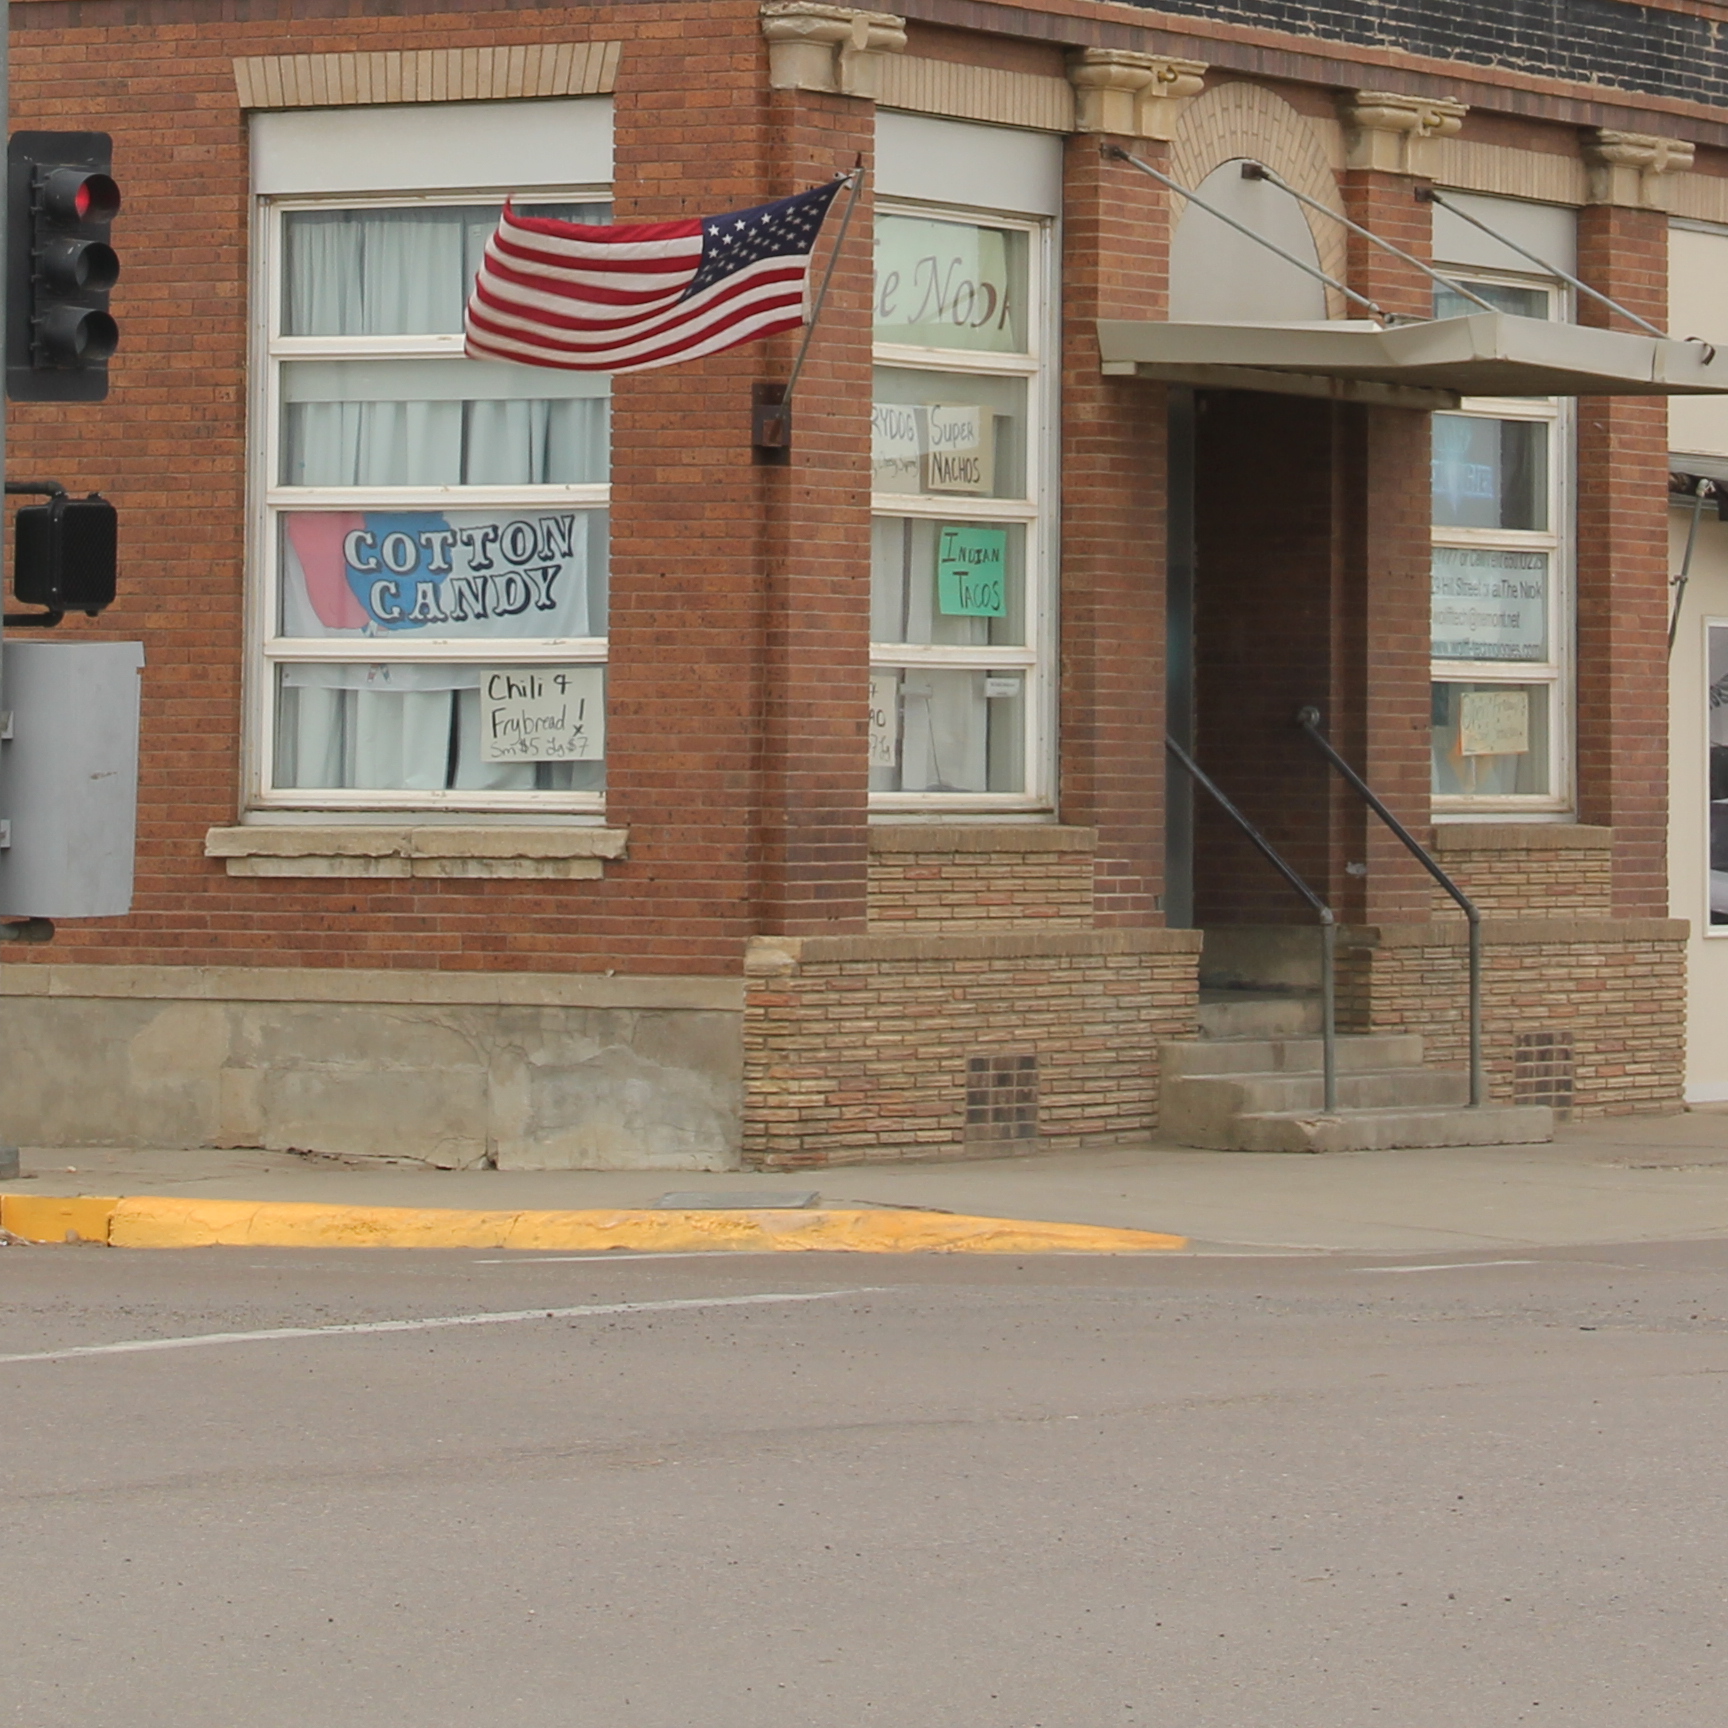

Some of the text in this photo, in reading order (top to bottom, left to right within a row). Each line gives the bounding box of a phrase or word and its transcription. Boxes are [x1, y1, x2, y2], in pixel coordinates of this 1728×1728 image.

[931, 451, 981, 486] NACHOS
[343, 514, 575, 574] COTTON
[369, 564, 563, 623] CANDY
[952, 571, 1001, 611] TACOS
[488, 674, 543, 701] Chili
